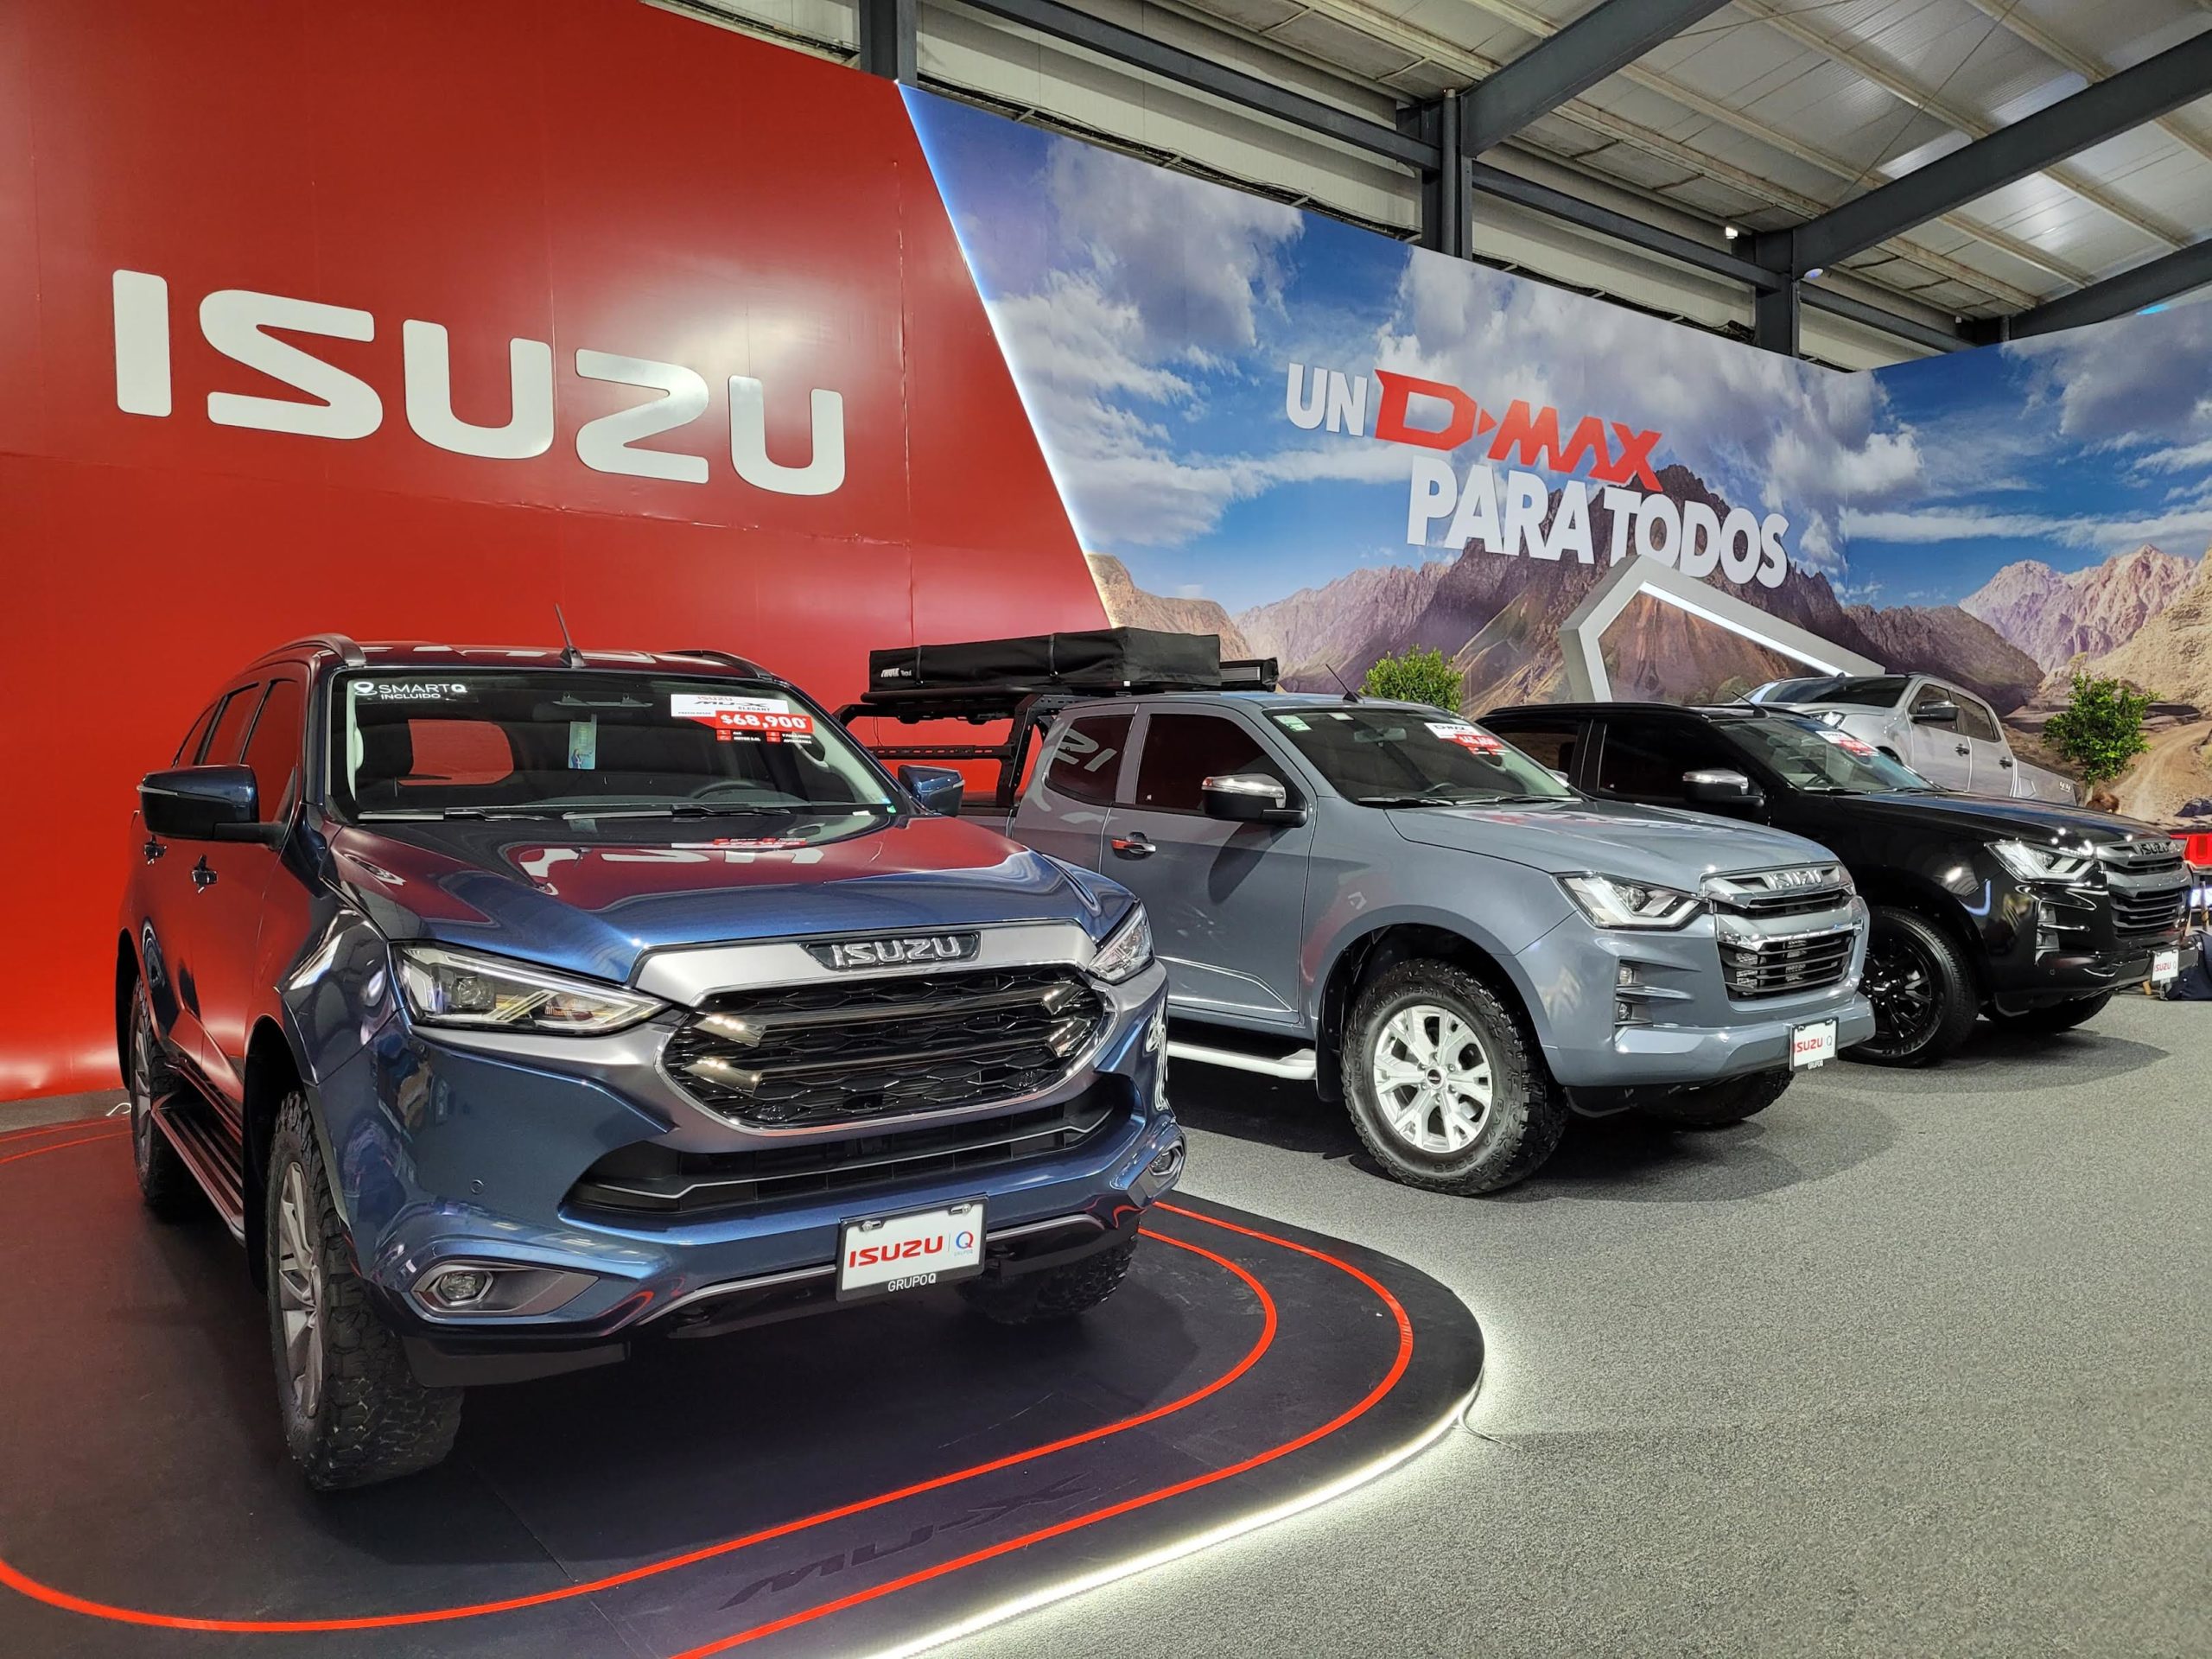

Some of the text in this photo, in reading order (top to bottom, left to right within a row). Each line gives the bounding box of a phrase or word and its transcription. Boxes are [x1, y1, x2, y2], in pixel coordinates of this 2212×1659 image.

[112, 269, 845, 495] ISUZU
[1286, 363, 1368, 436] UN
[1406, 455, 1789, 588] PARA TODOS
[831, 936, 961, 968] ISUZU
[2155, 961, 2171, 972] SUZU
[849, 1230, 974, 1268] ISUZU Q
[887, 1273, 937, 1292] GRUPOQ
